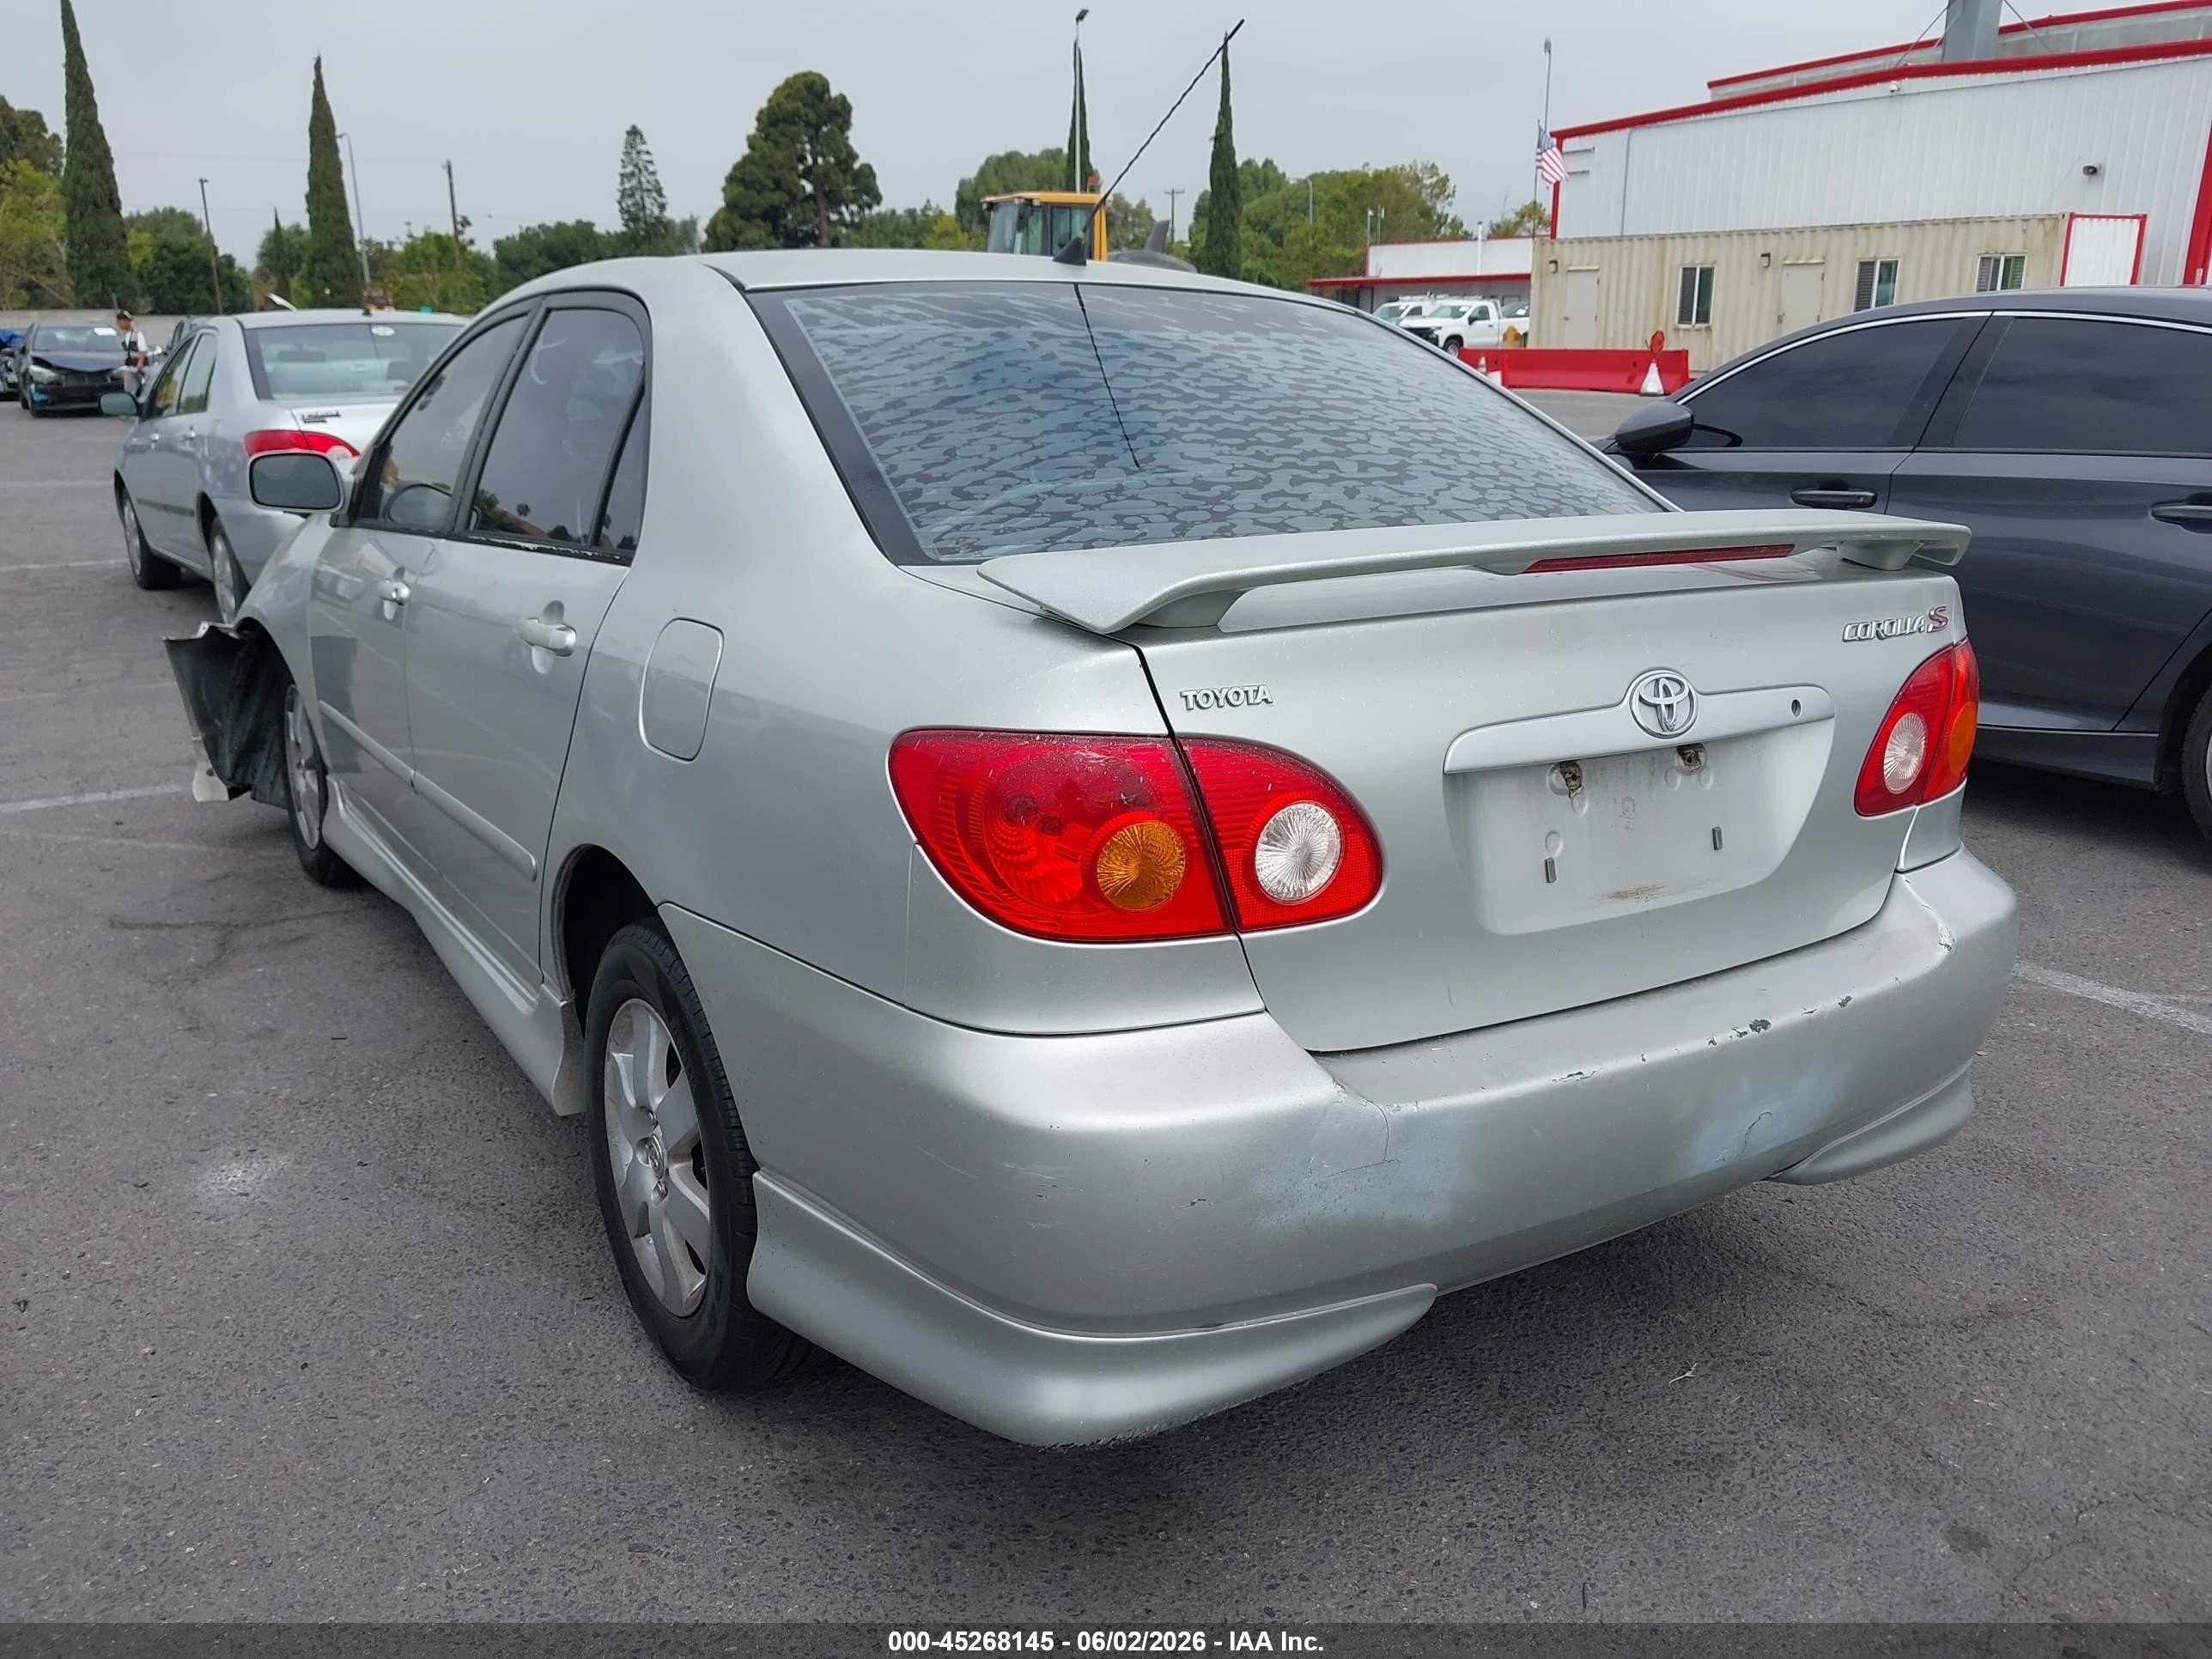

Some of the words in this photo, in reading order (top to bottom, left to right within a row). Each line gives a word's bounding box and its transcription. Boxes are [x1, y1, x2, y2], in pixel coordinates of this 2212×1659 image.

[1842, 615, 1925, 642] COROLLA
[1926, 605, 1949, 633] S
[1180, 684, 1273, 711] TOYOTA
